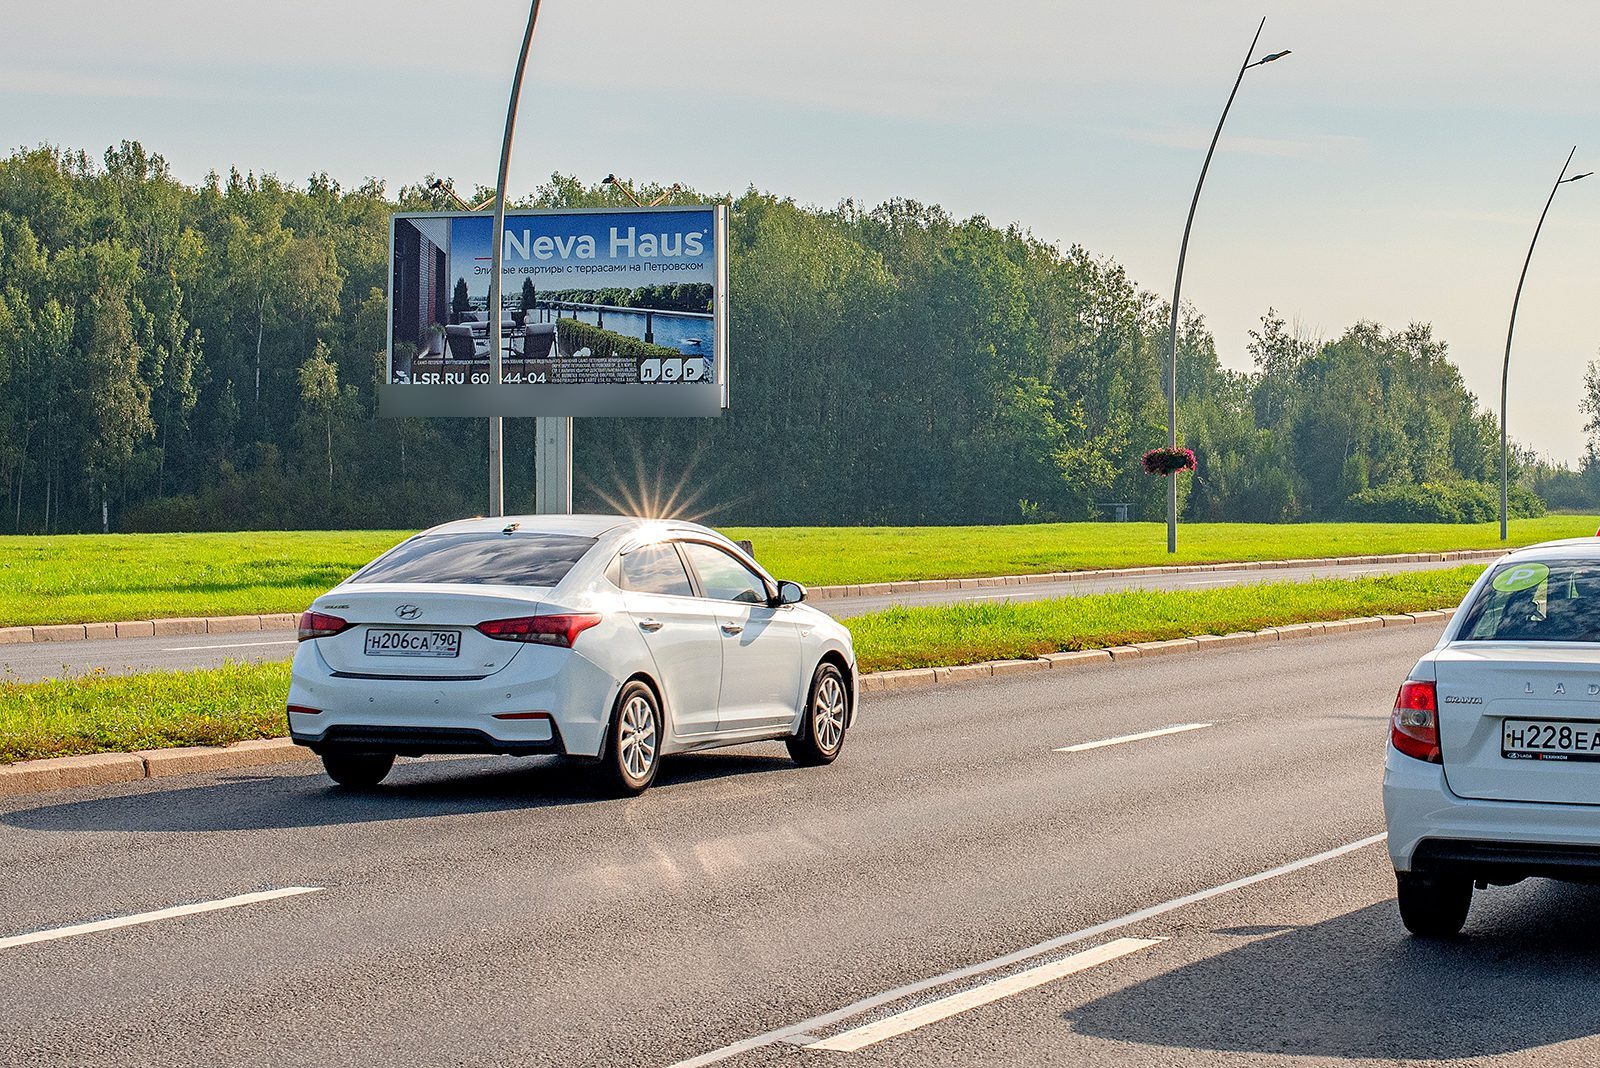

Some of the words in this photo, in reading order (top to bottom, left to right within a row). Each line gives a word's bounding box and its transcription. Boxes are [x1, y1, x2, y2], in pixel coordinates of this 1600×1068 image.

[504, 229, 596, 261] Neva
[473, 265, 516, 276] Элиые
[518, 265, 564, 276] квартиры
[566, 265, 573, 273] с
[575, 264, 627, 275] террасами
[629, 263, 641, 272] на
[643, 261, 704, 274] Петровском
[413, 372, 465, 385] LSR.RU
[470, 372, 547, 384] 6044-04
[432, 633, 455, 646] 790
[1444, 695, 1483, 704] GRANTA
